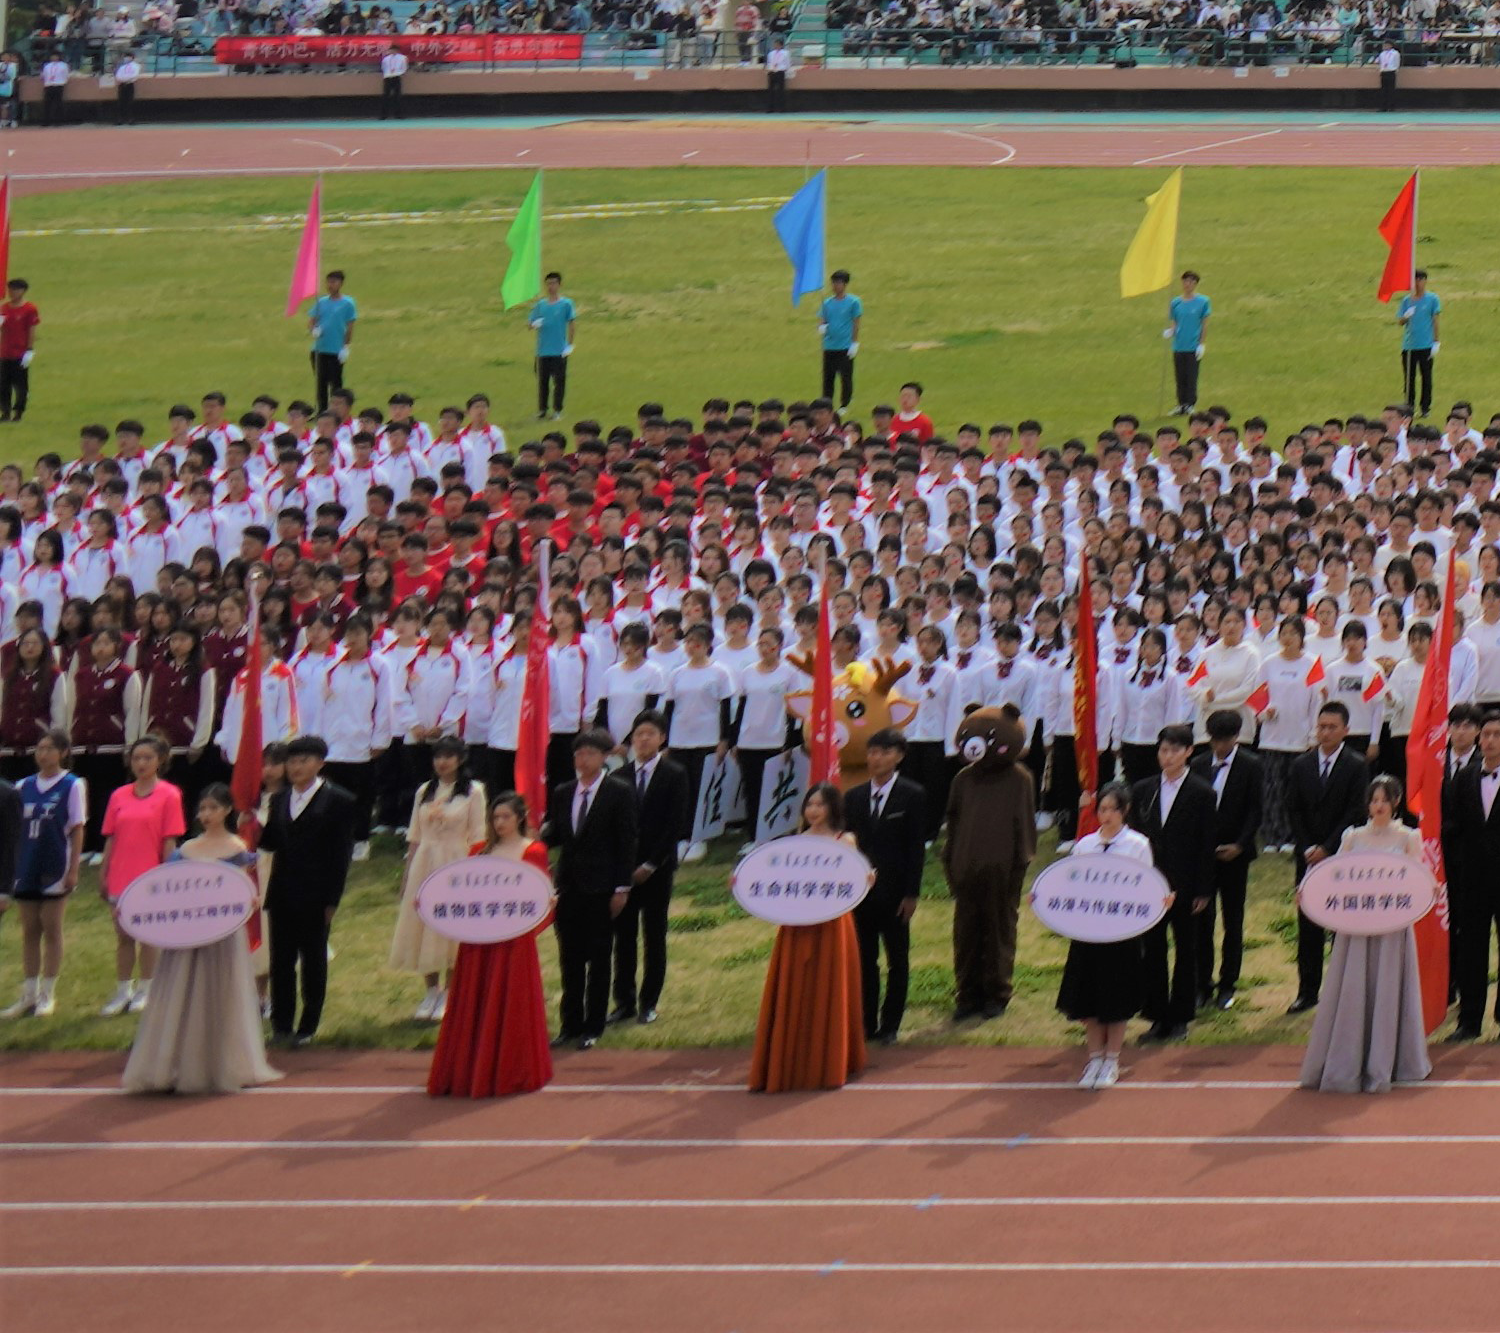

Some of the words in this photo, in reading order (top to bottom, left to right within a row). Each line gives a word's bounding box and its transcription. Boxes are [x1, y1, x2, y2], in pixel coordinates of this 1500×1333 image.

[749, 880, 855, 899] 生命科学学院
[433, 900, 537, 919] 植物医学学院
[1047, 898, 1151, 918] 动漫与传媒学院
[1325, 893, 1413, 911] 外国语学院
